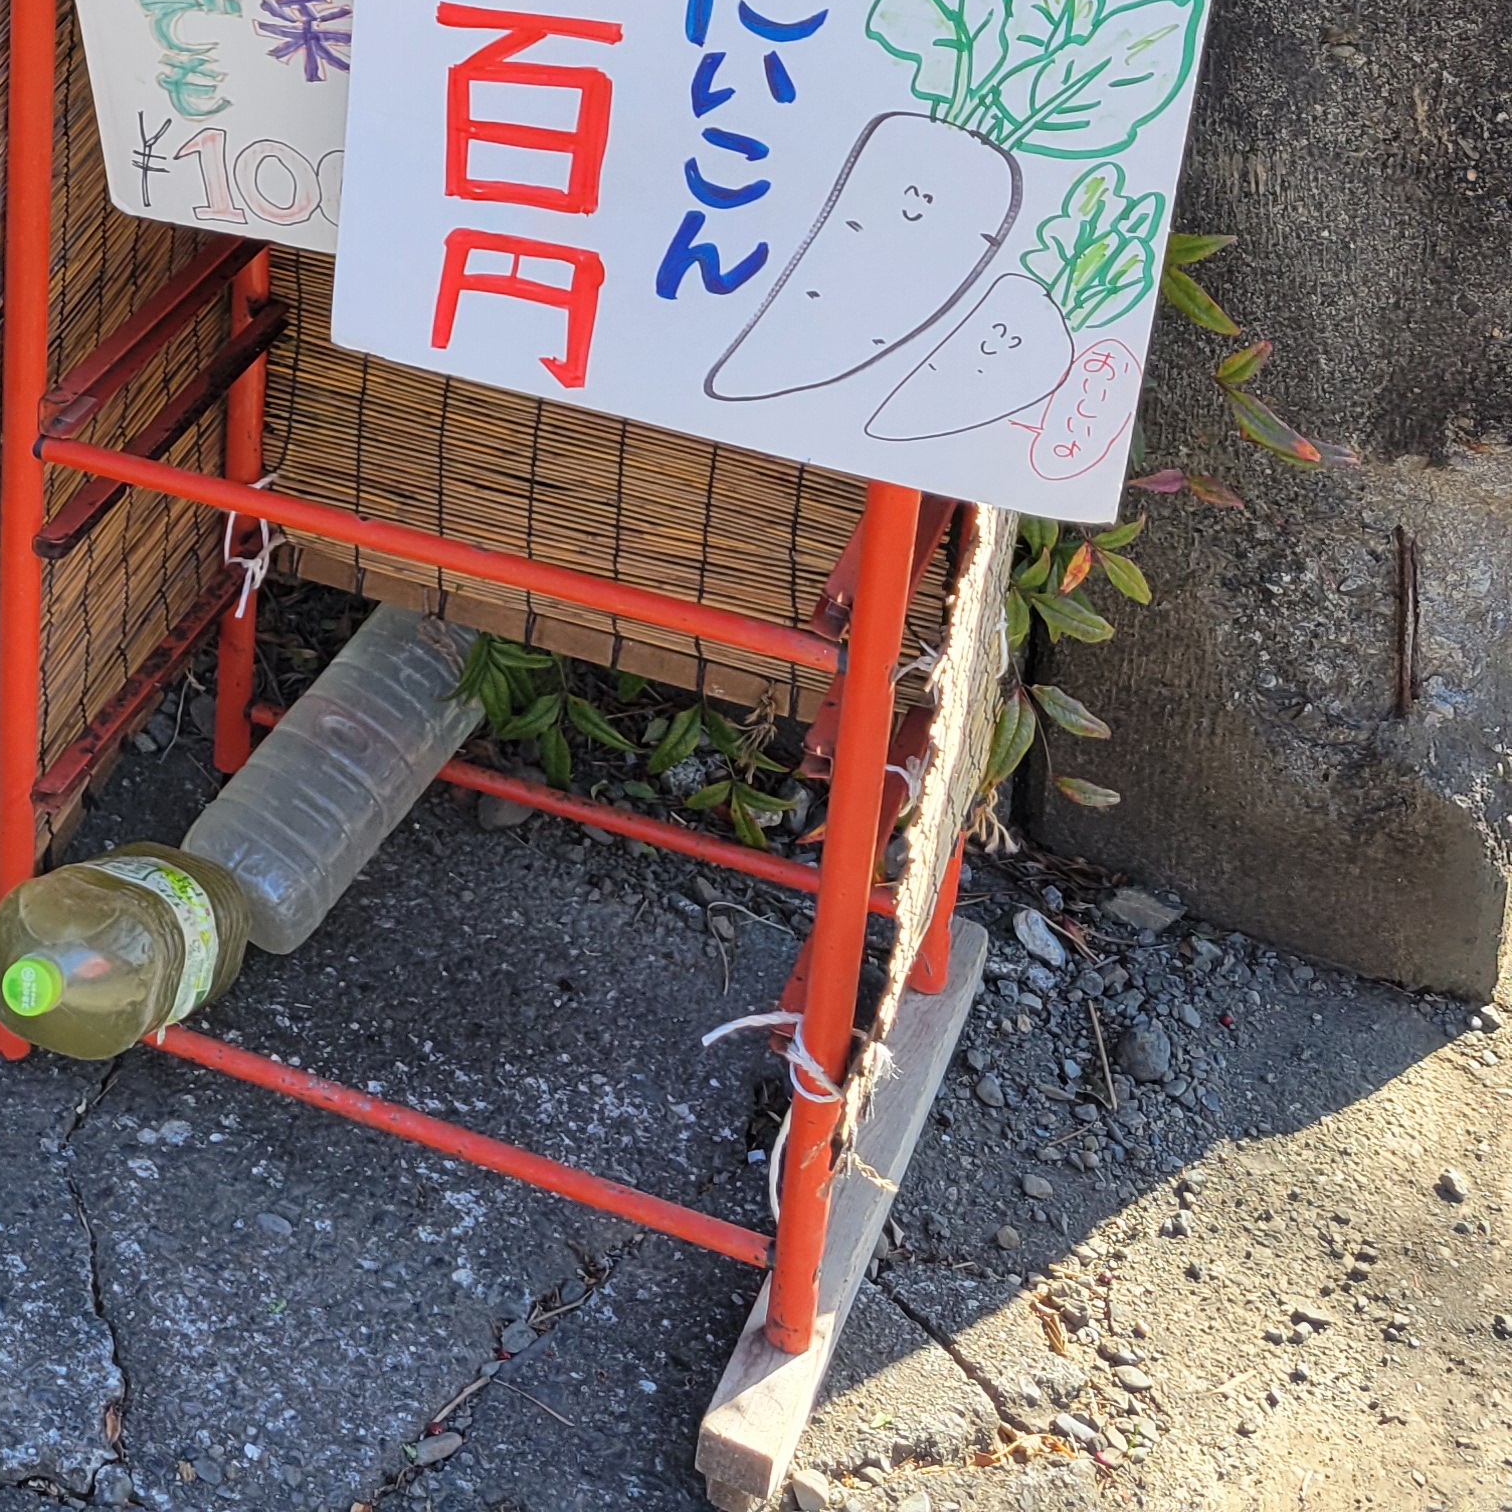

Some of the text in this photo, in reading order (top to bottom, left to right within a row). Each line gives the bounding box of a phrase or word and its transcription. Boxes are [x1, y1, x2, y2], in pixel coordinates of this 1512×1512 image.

[429, 0, 625, 392] 百円
[1052, 351, 1130, 460] おいしいよ
